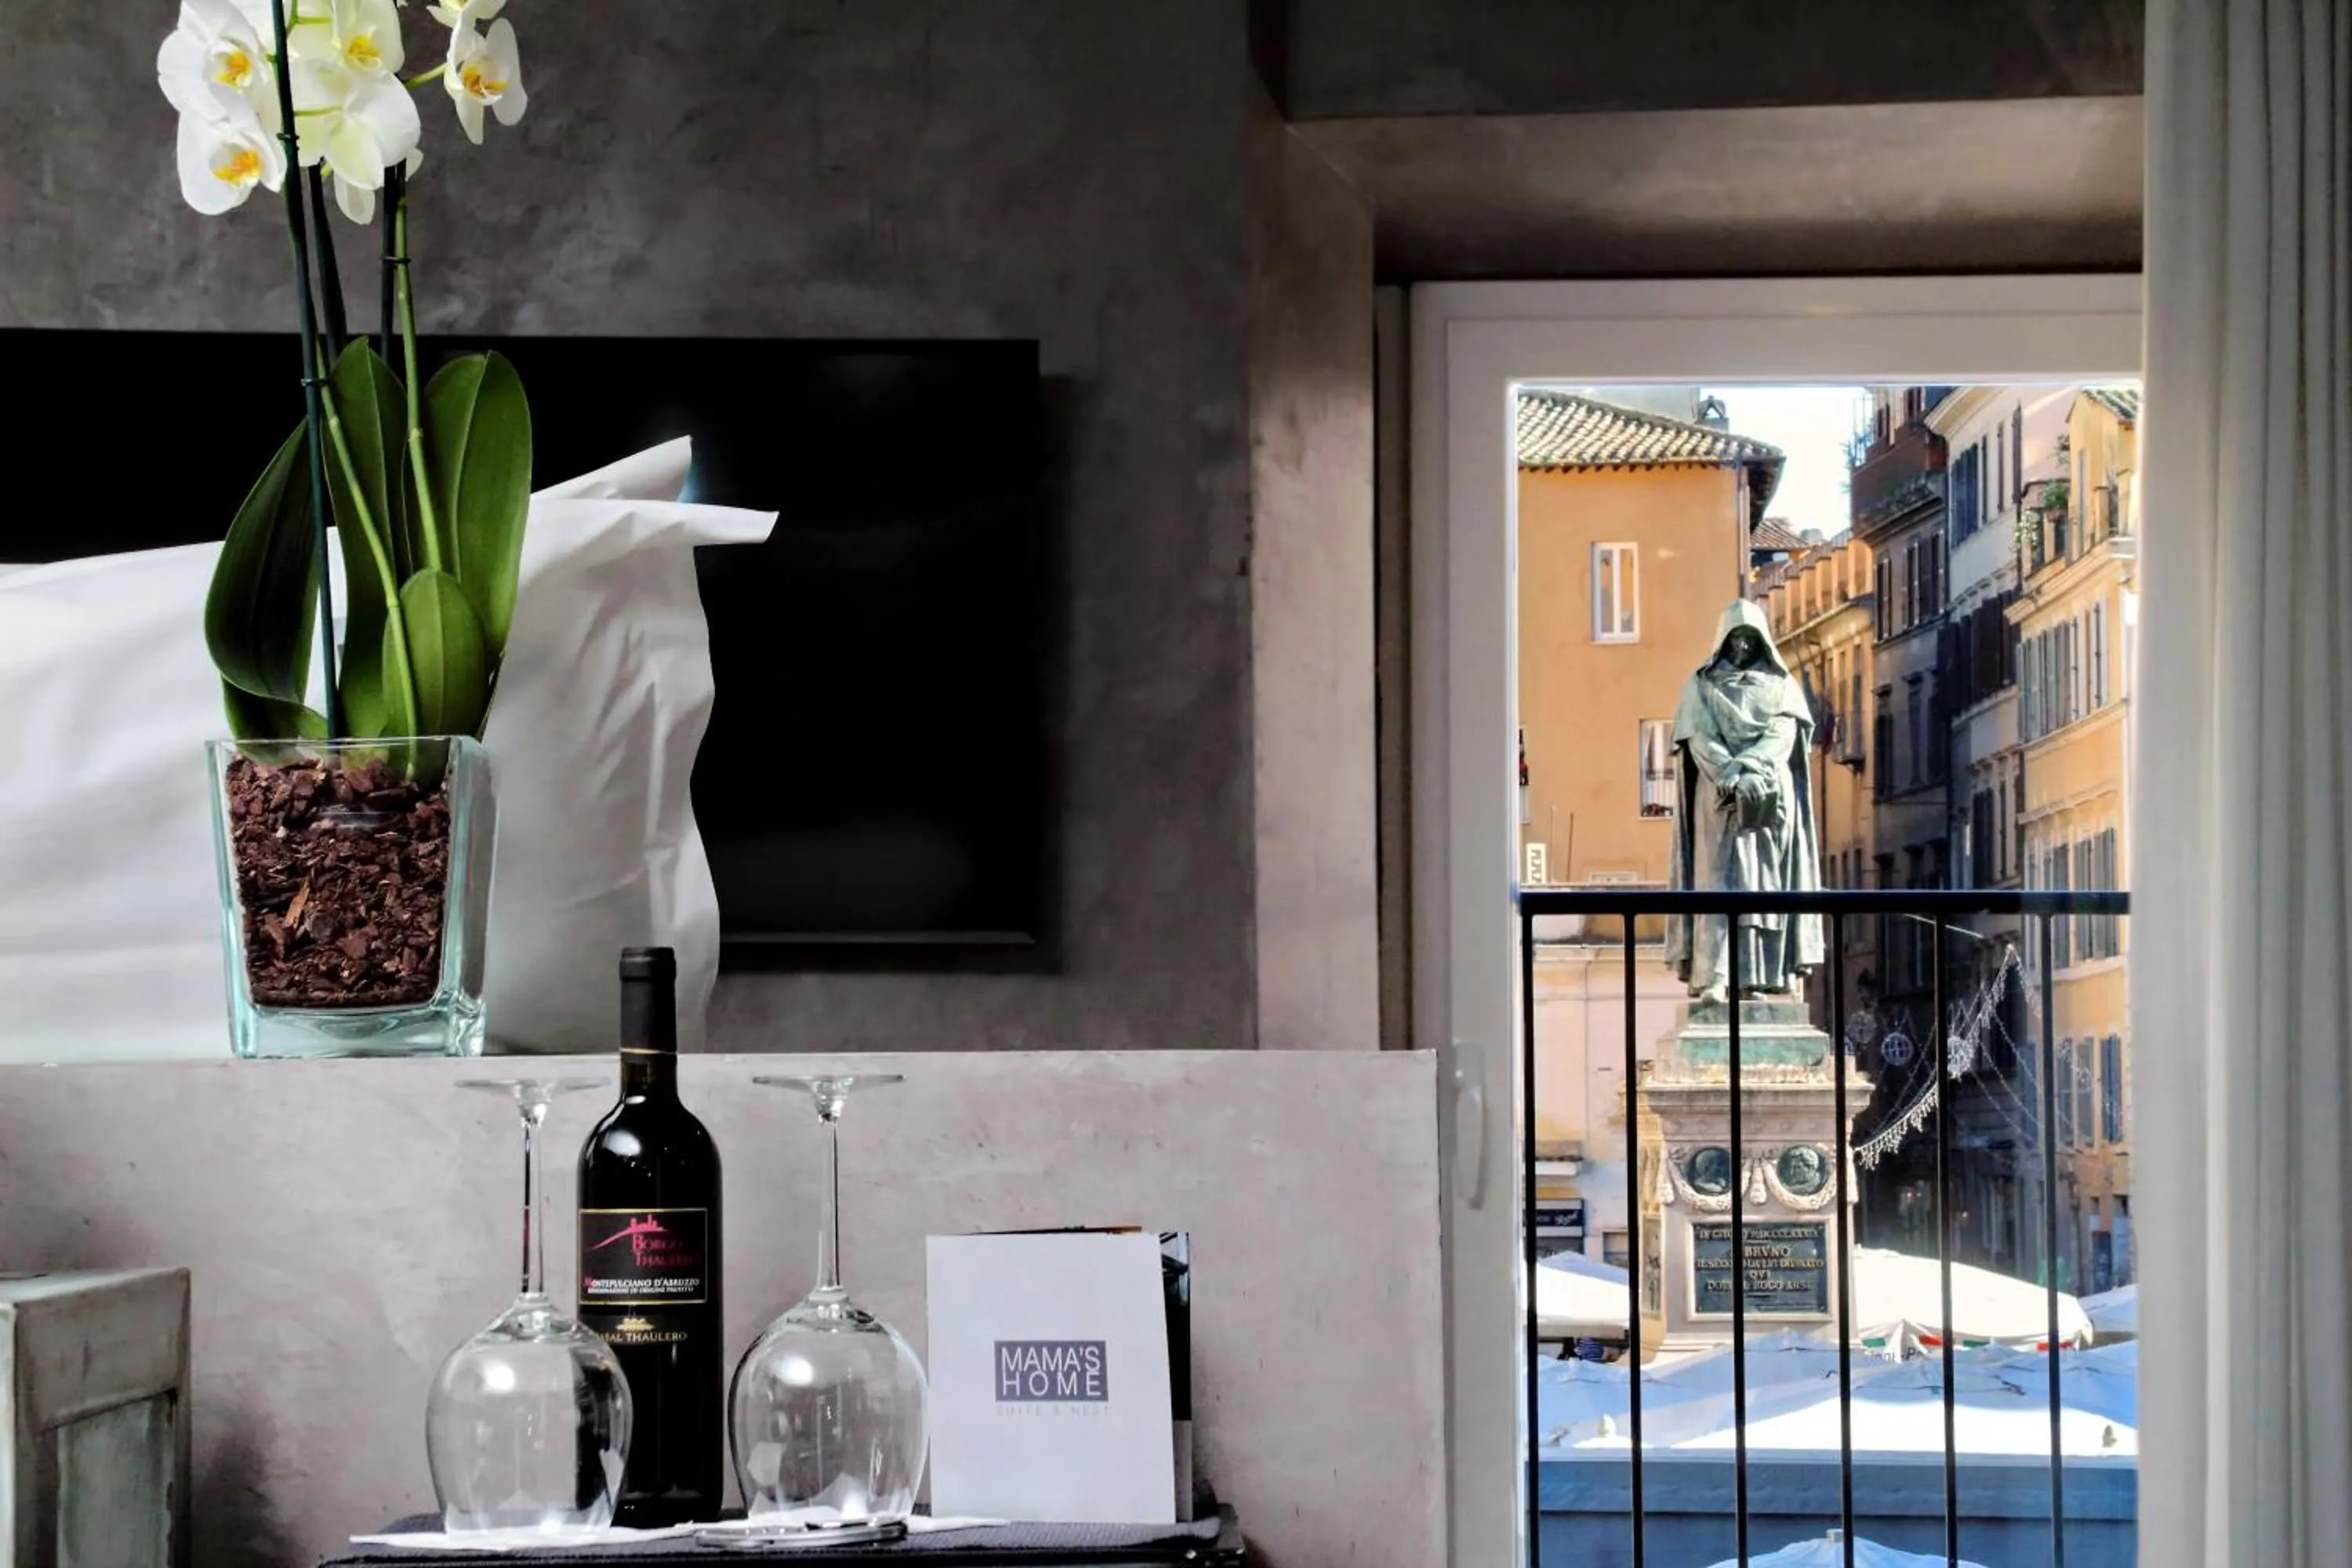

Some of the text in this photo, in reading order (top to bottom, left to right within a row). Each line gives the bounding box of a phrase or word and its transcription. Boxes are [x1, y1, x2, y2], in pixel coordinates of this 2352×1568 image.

[625, 1331, 688, 1342] THAULERO
[1001, 1346, 1101, 1372] MAMA'S
[1002, 1371, 1102, 1396] HOME
